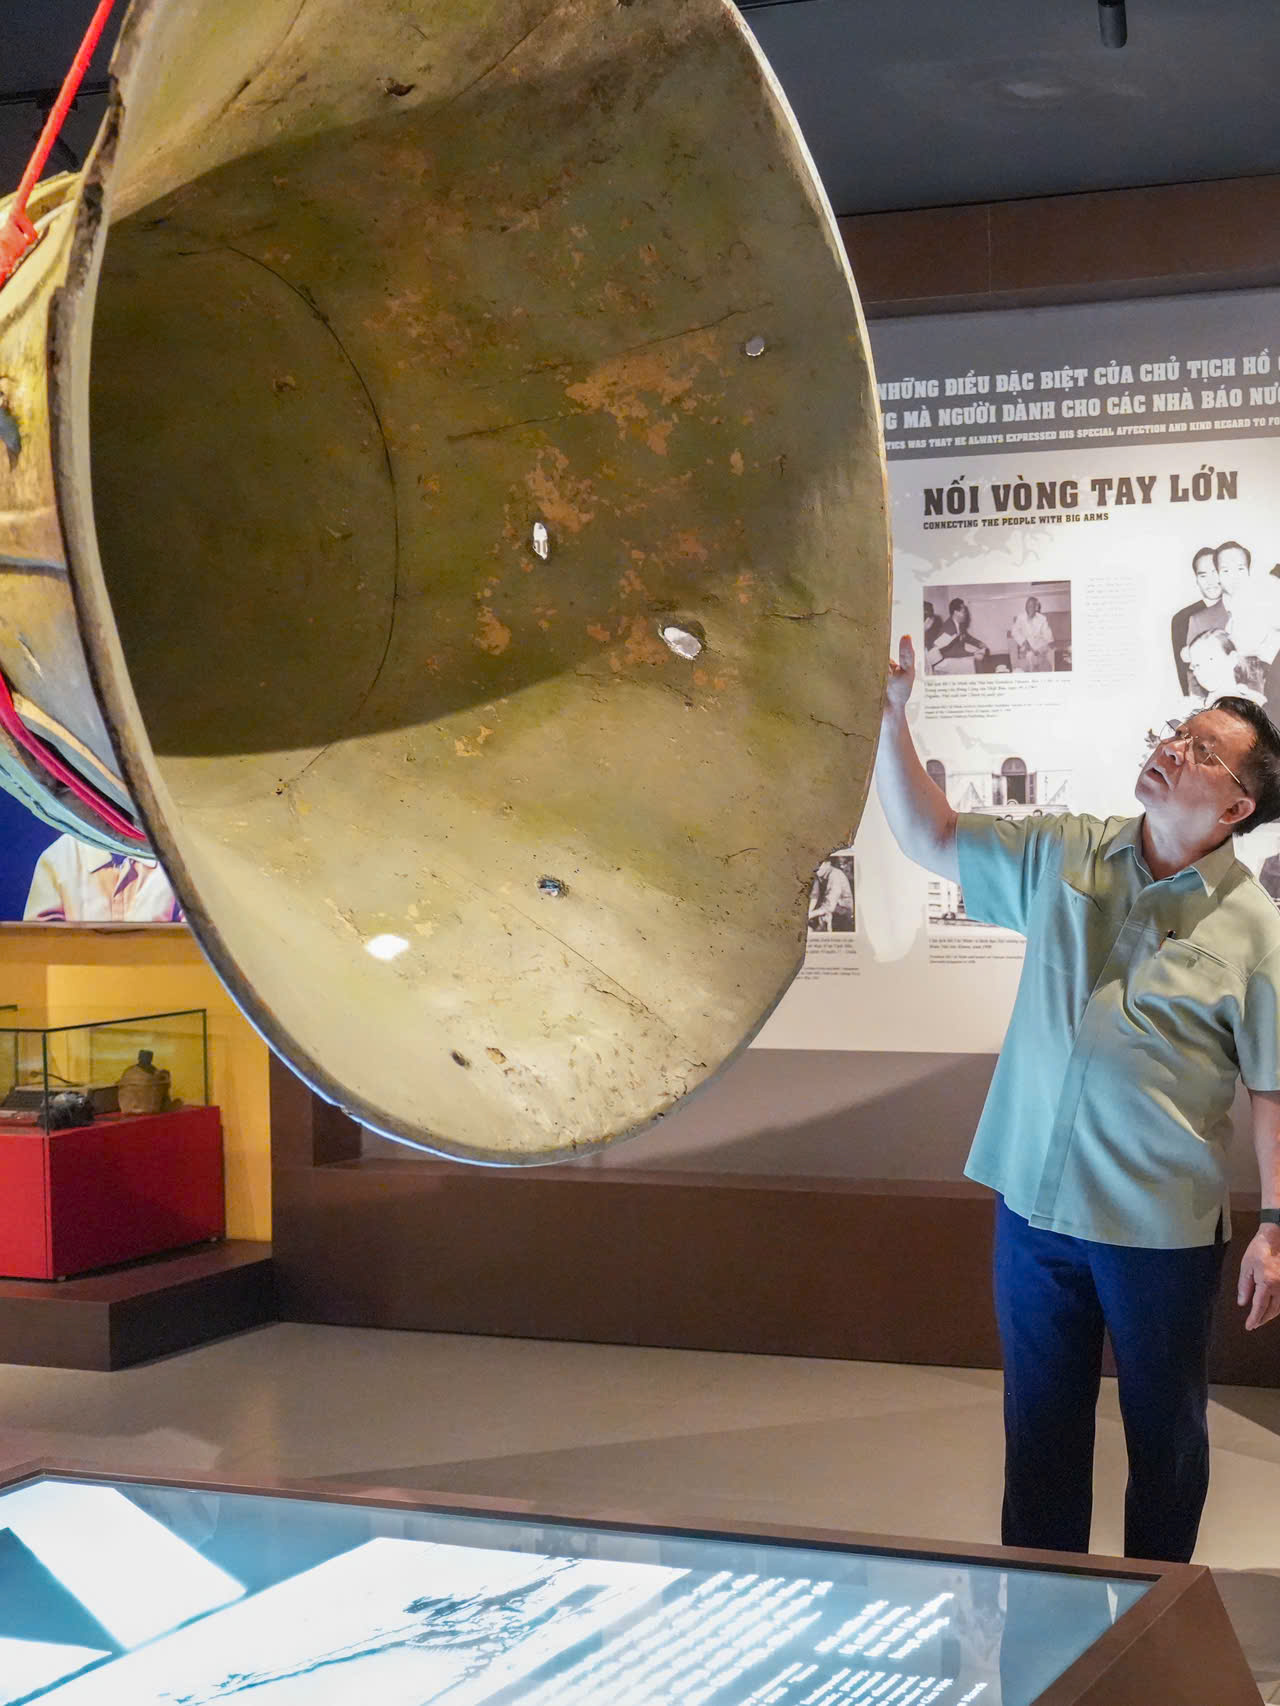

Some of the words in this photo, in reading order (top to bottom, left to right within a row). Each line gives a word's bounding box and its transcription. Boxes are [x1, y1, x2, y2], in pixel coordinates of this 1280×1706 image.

[877, 377, 939, 400] NHỮNG
[945, 369, 990, 396] ĐIỀU
[996, 369, 1034, 395] ĐẶC
[1041, 366, 1088, 392] BIỆT
[1094, 360, 1134, 385] CỦA
[1139, 355, 1180, 383] CHỦ
[1187, 357, 1235, 382] TỊCH
[1243, 348, 1270, 375] HỒ
[904, 405, 932, 429] MÀ
[939, 400, 996, 426] NGƯỜI
[1002, 398, 1055, 423] DÀNH
[1062, 397, 1100, 418] CHO
[1107, 390, 1146, 414] CÁC
[1153, 387, 1193, 412] NHÀ
[1201, 384, 1243, 408] BÁO
[907, 439, 926, 448] WAS
[928, 437, 952, 447] THAT
[954, 436, 966, 445] HE
[968, 434, 1004, 444] ALWAYS
[1005, 431, 1057, 442] EXPRESSED
[1058, 430, 1074, 438] HIS
[1076, 427, 1114, 437] SPECIAL
[1116, 424, 1166, 435] AFFECTION
[1168, 422, 1187, 432] AND
[1189, 421, 1212, 430] KIND
[1214, 418, 1251, 428] REGARD
[1252, 417, 1266, 426] TO
[924, 474, 979, 516] NỐI
[992, 474, 1078, 512] VÒNG
[1090, 475, 1156, 507] TAY
[1171, 464, 1238, 502] LỚN
[923, 519, 978, 529] CONNECTING
[981, 518, 999, 526] THE
[1001, 516, 1036, 525] PEOPLE
[1038, 515, 1062, 523] WITH
[1065, 514, 1080, 522] BIG
[1083, 513, 1109, 521] ARMS
